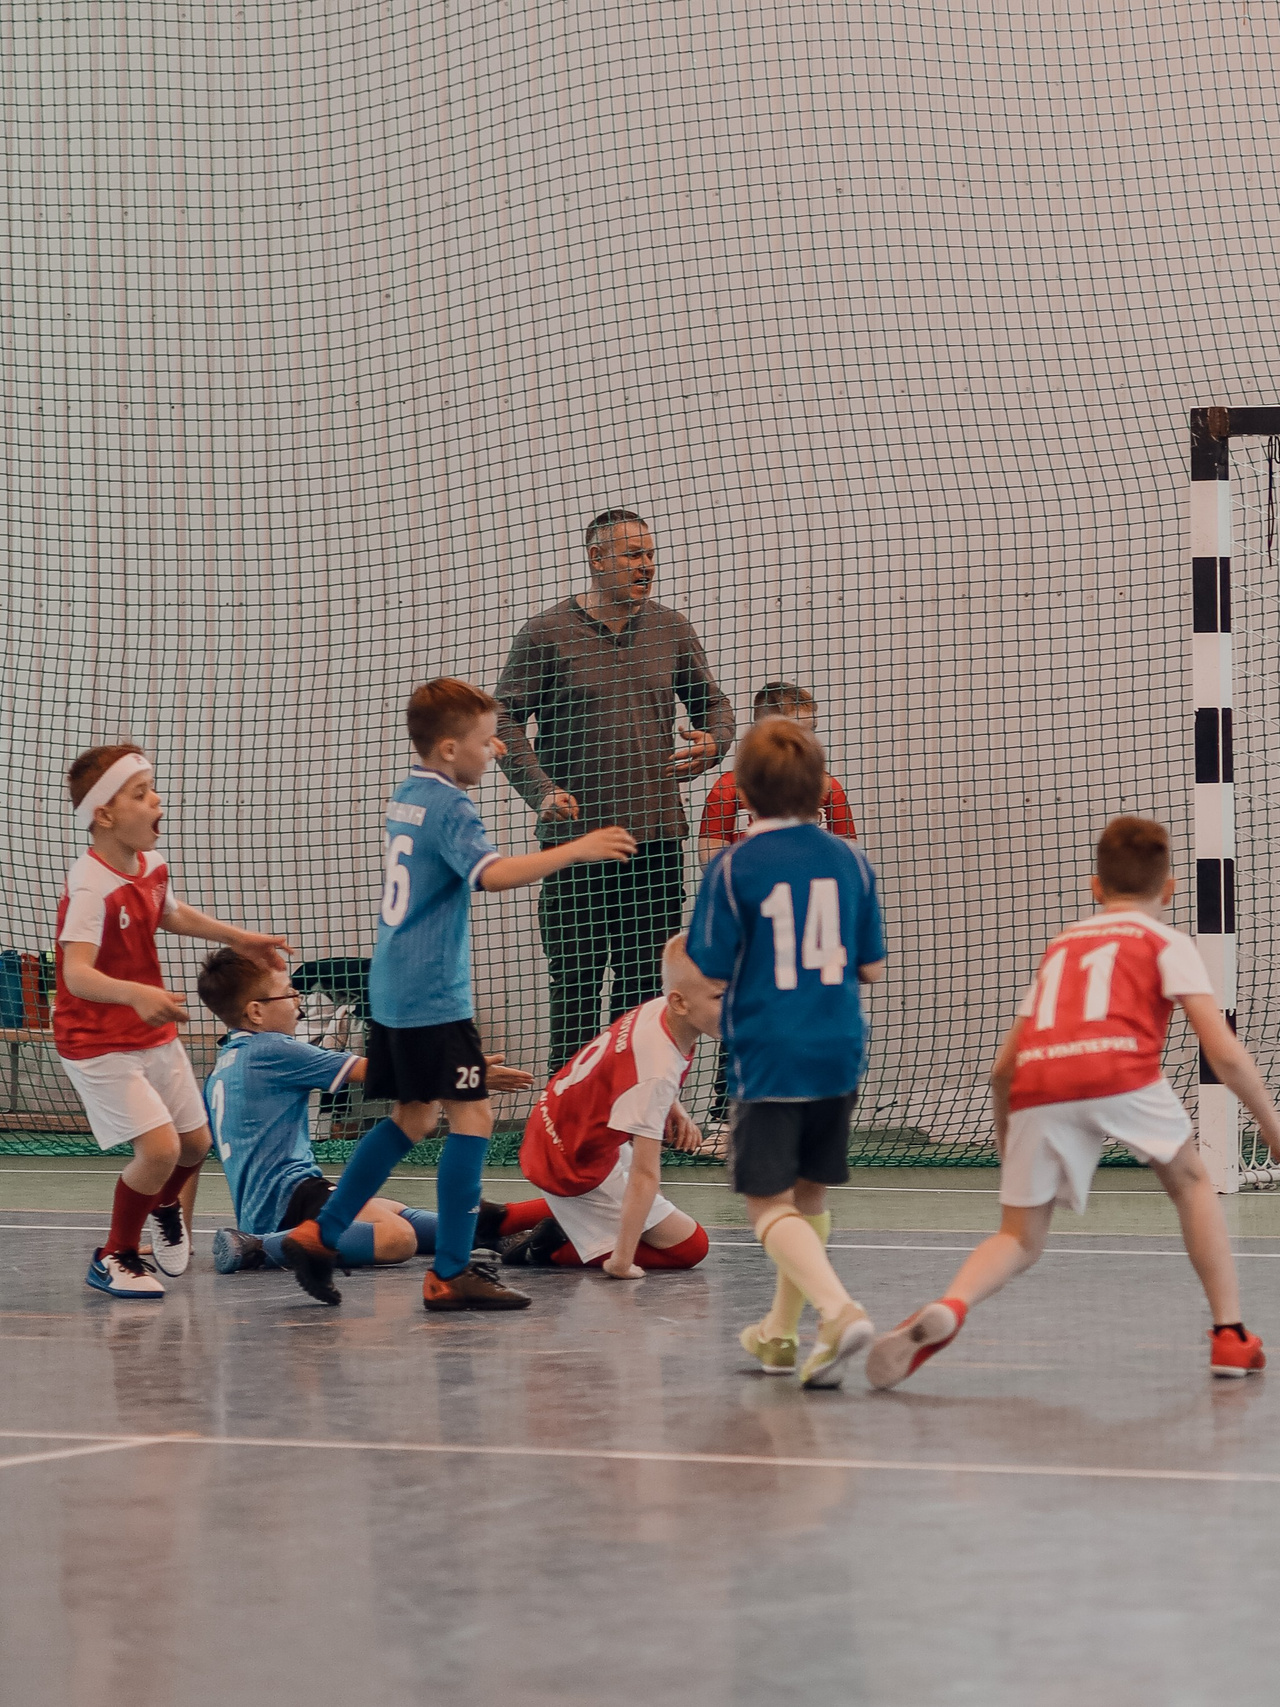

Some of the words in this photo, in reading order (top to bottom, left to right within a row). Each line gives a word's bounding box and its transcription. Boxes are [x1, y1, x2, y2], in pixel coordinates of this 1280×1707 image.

[119, 906, 131, 930] 6
[760, 878, 848, 990] 14
[1036, 941, 1121, 1031] 11
[455, 1066, 480, 1089] 26
